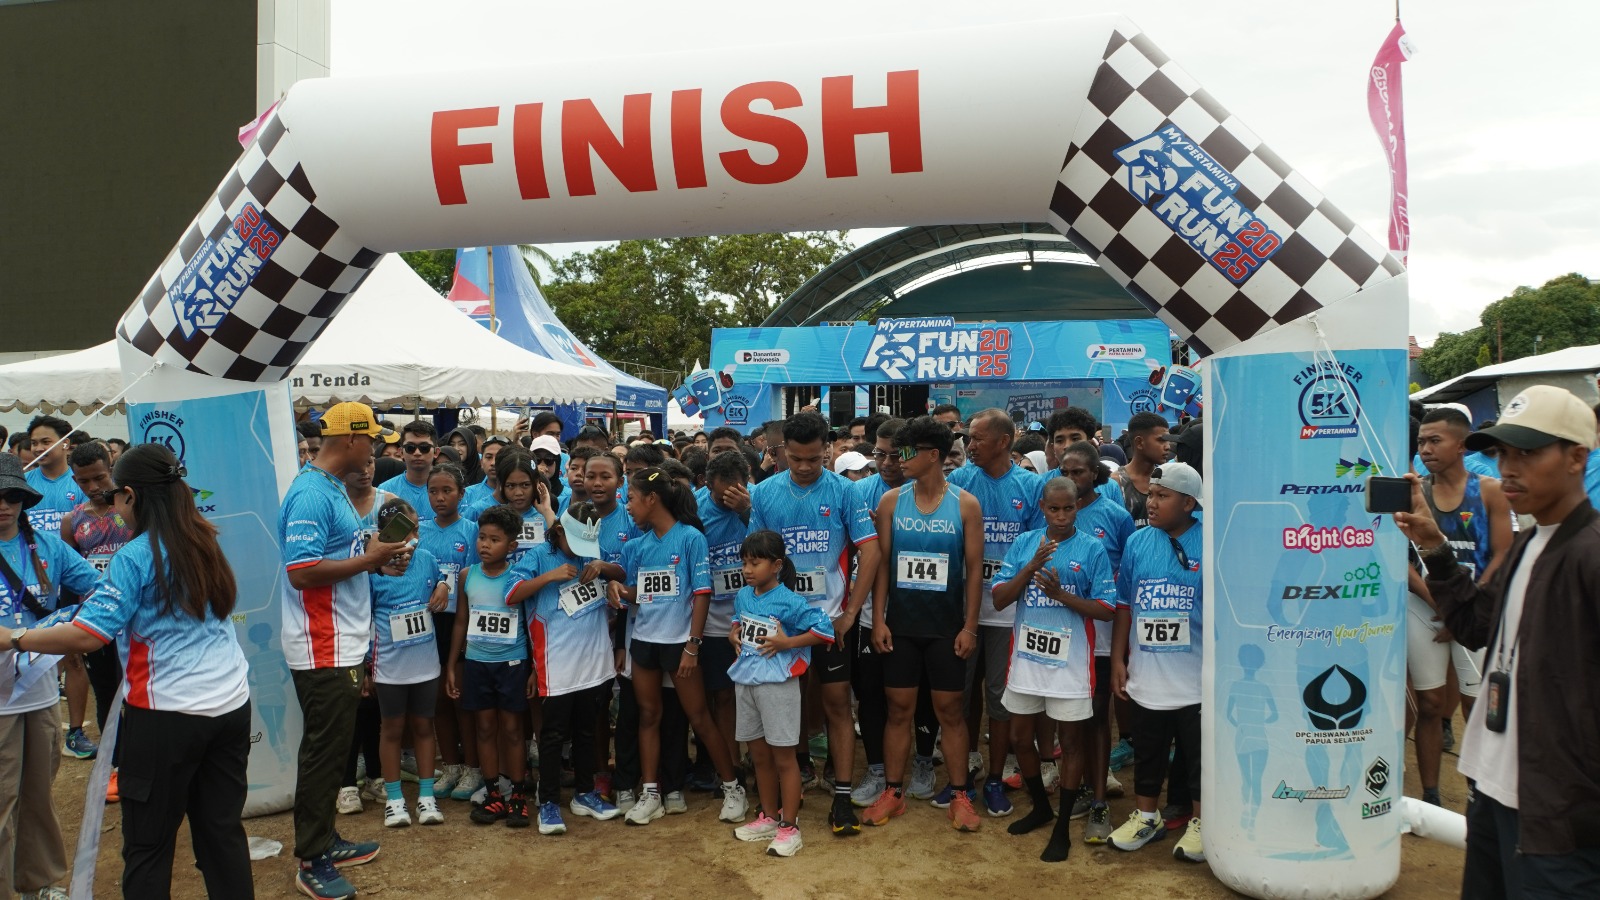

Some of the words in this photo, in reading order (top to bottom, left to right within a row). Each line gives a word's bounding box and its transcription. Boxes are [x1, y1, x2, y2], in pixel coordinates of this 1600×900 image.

[430, 69, 923, 205] FINISH
[310, 372, 371, 387] Tenda
[1293, 360, 1363, 385] FINISHER
[729, 408, 744, 417] 5K
[1311, 393, 1350, 416] 5K
[139, 410, 184, 429] FINISHER
[895, 517, 956, 534] INDONESIA
[1285, 526, 1341, 552] Bright
[1342, 528, 1373, 546] Gas
[907, 562, 938, 580] 144
[571, 582, 598, 605] 195
[644, 575, 671, 593] 288
[1282, 583, 1381, 600] DEXLITE
[405, 615, 426, 635] 111
[476, 615, 510, 634] 499
[1144, 622, 1181, 642] 767
[1026, 631, 1062, 655] 590
[1266, 625, 1333, 647] Energizing
[1334, 626, 1359, 646] Your
[1359, 623, 1395, 643] Journey
[1333, 736, 1366, 744] SELATAN
[1351, 728, 1374, 736] MIGAS
